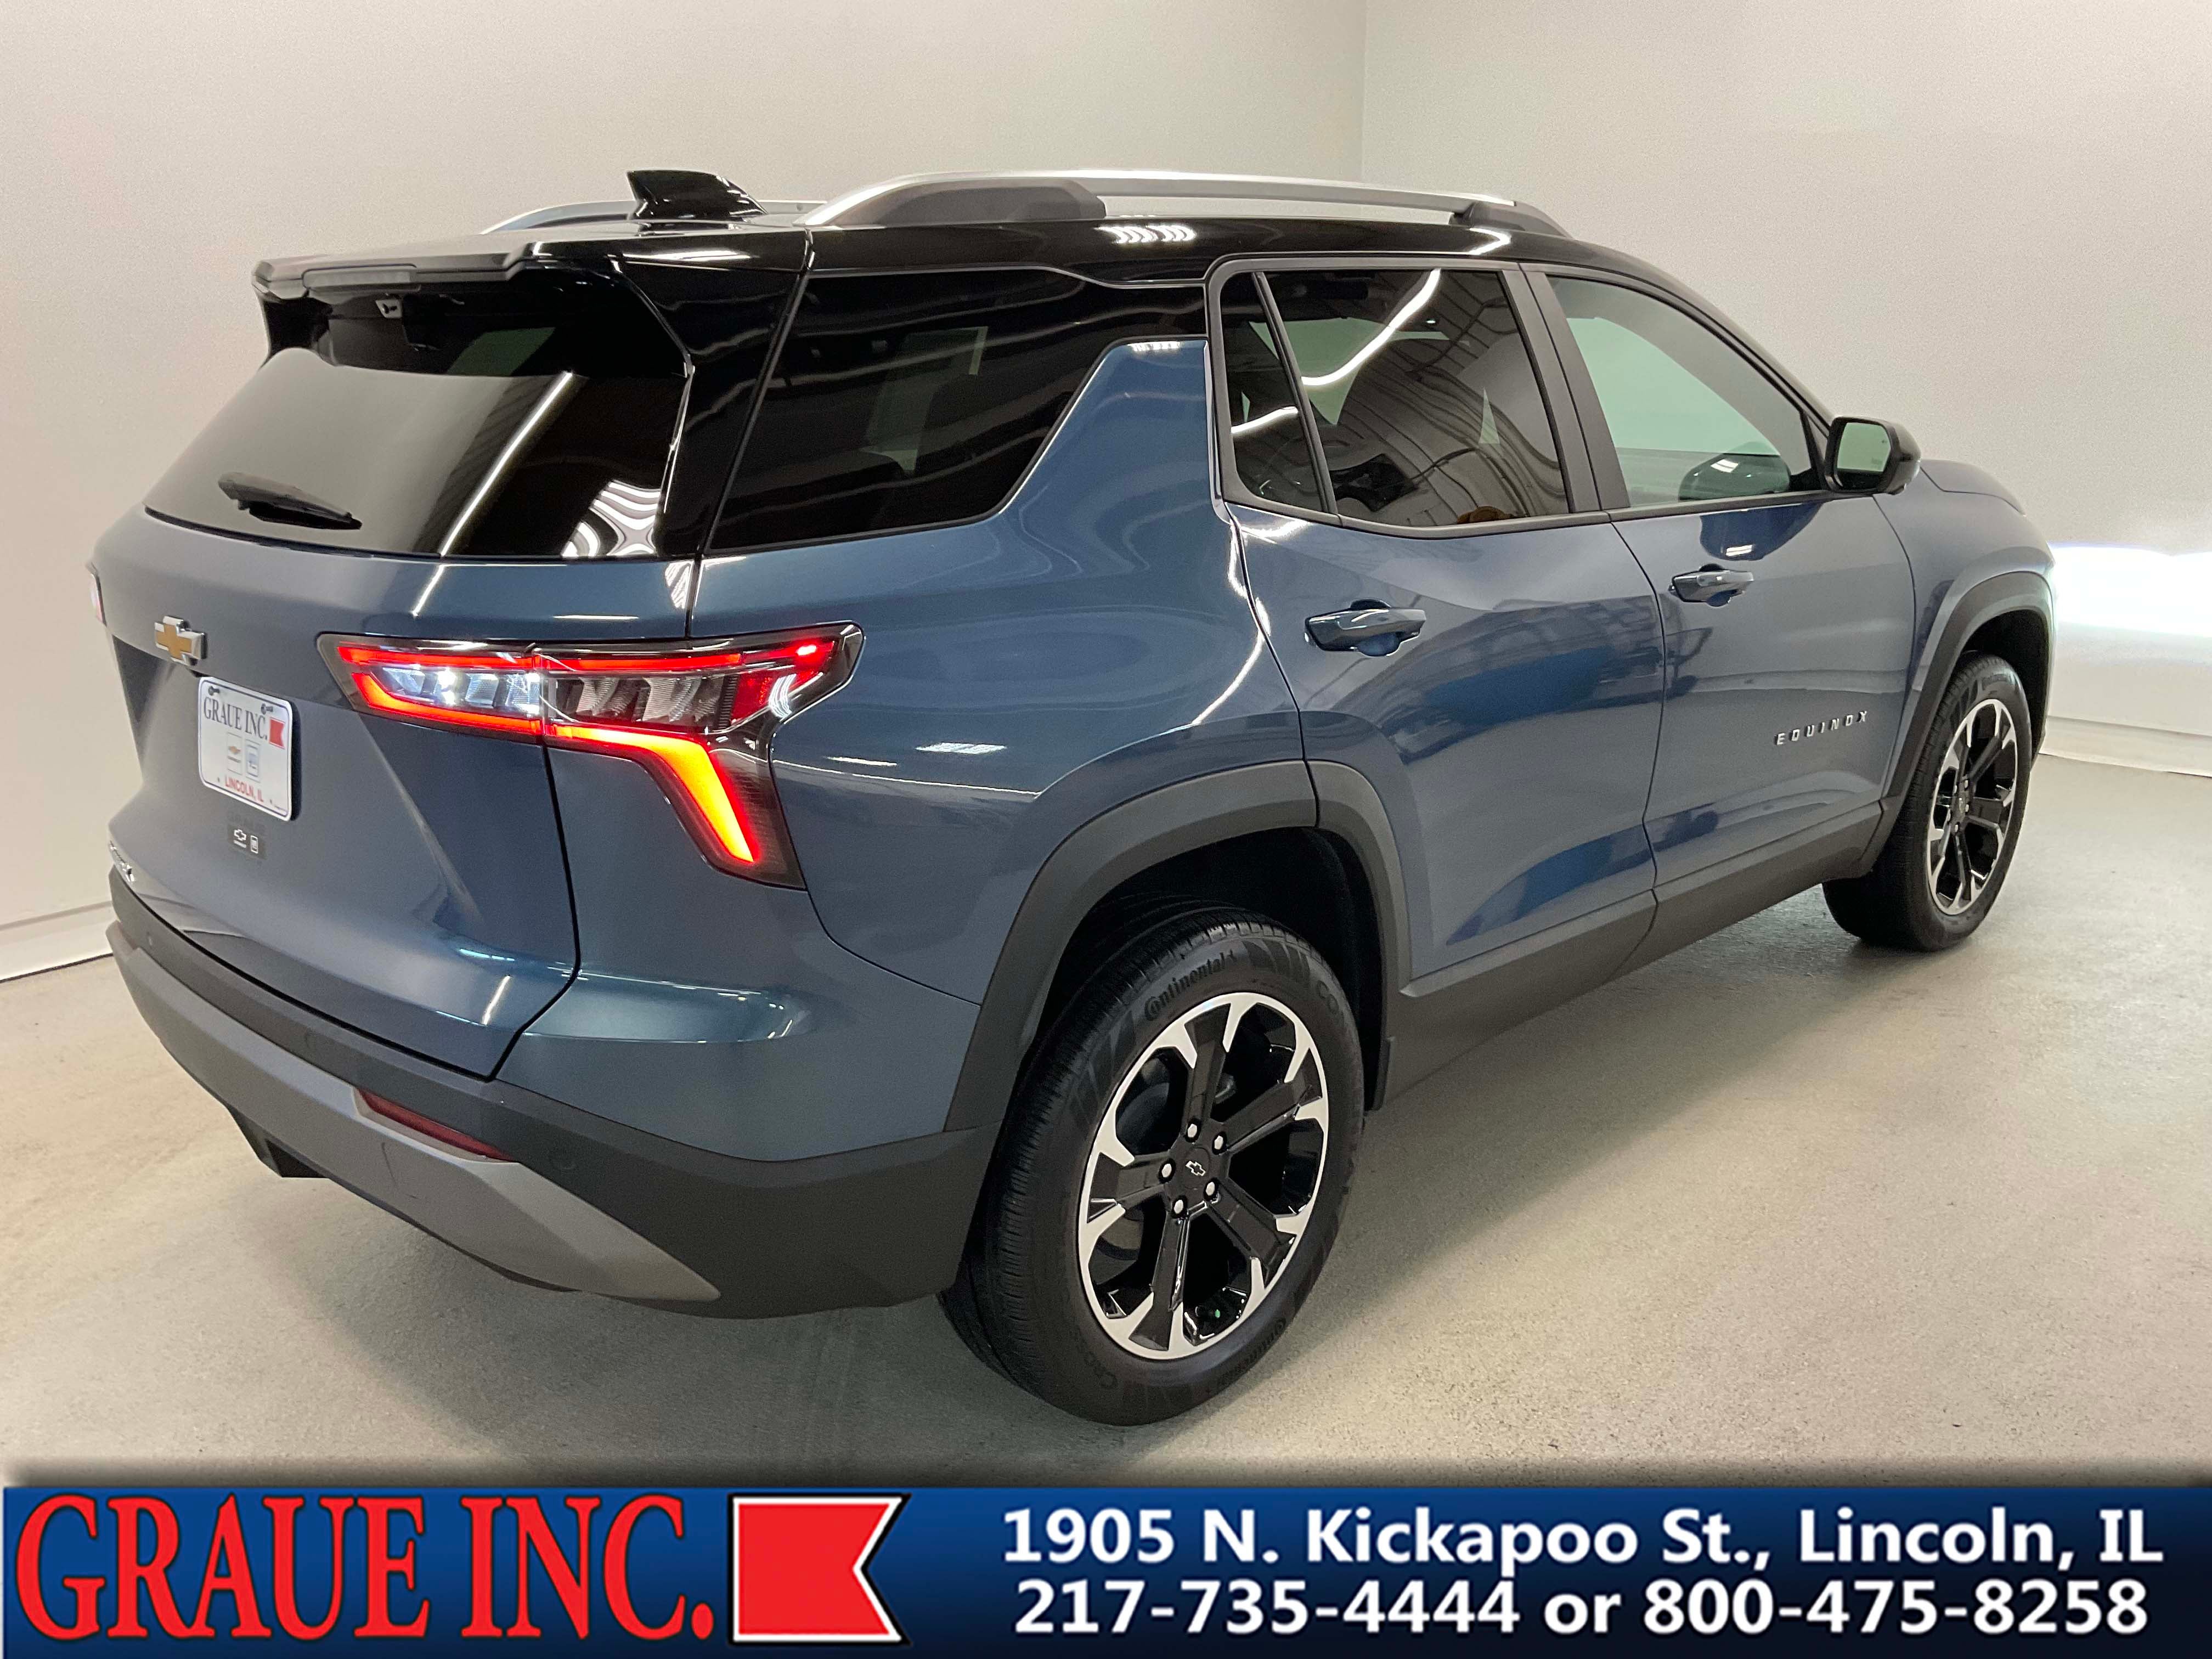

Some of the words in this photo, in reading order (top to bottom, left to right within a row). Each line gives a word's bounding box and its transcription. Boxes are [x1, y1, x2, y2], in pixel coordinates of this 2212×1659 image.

[203, 697, 242, 730] GRAUE
[245, 710, 268, 740] INC.
[1775, 710, 1867, 746] EQUINOX
[225, 775, 255, 799] LINCOLN,
[256, 789, 264, 803] IL
[1144, 951, 1226, 1022] Continental
